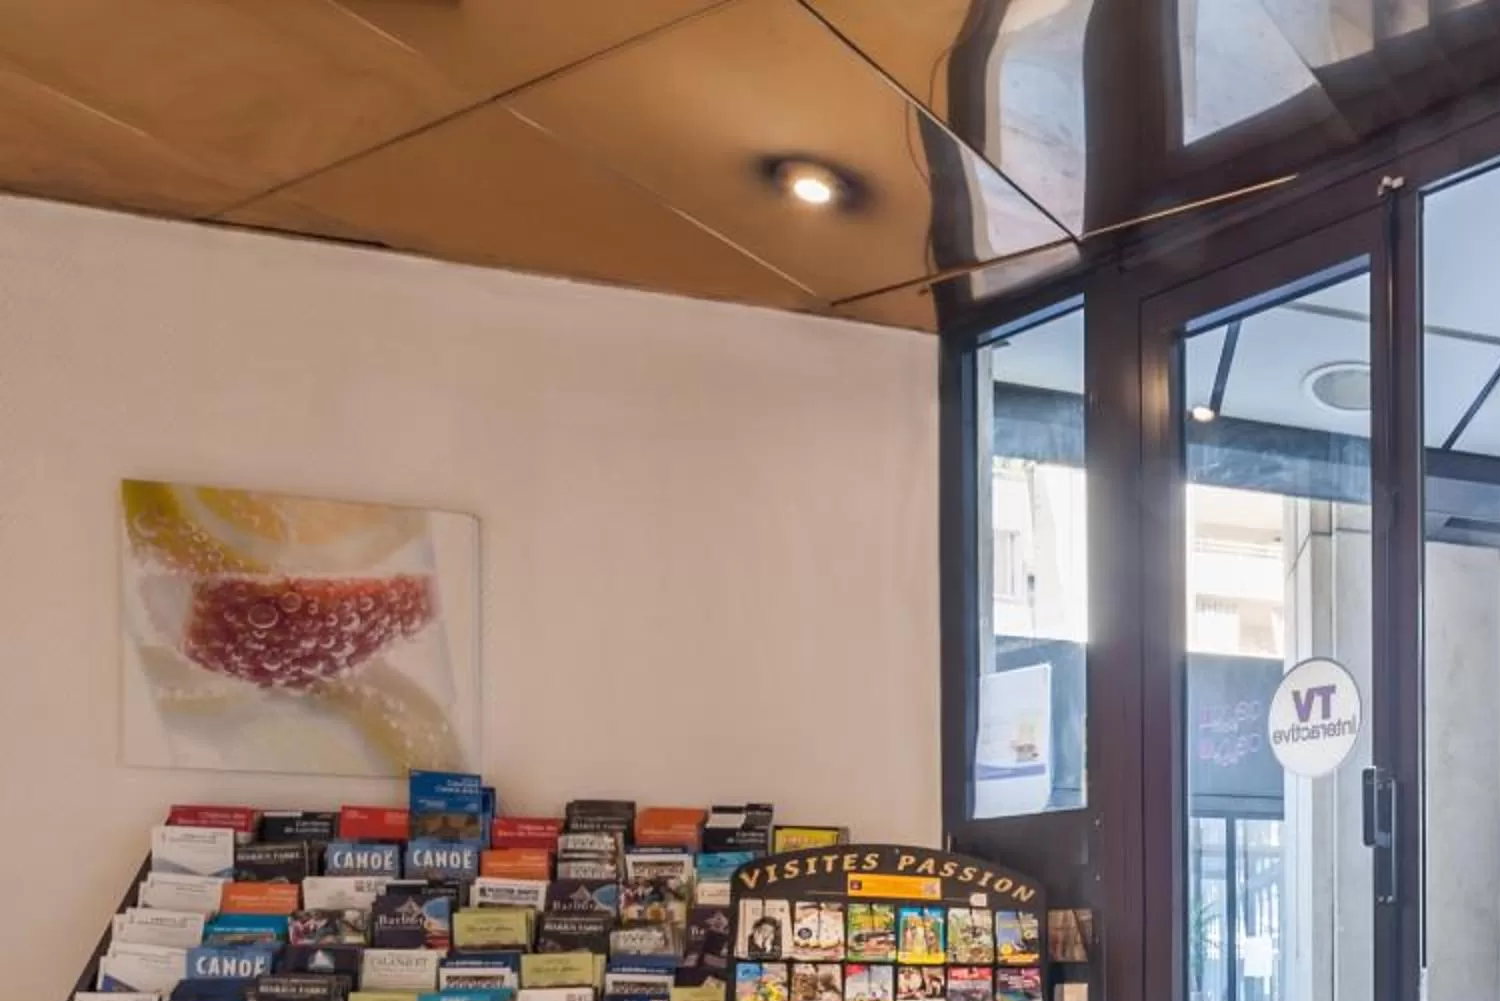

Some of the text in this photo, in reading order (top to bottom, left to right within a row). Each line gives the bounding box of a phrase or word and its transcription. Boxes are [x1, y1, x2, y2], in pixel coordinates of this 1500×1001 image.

[412, 848, 473, 870] CANOË
[739, 852, 1036, 903] VISITES PASSION
